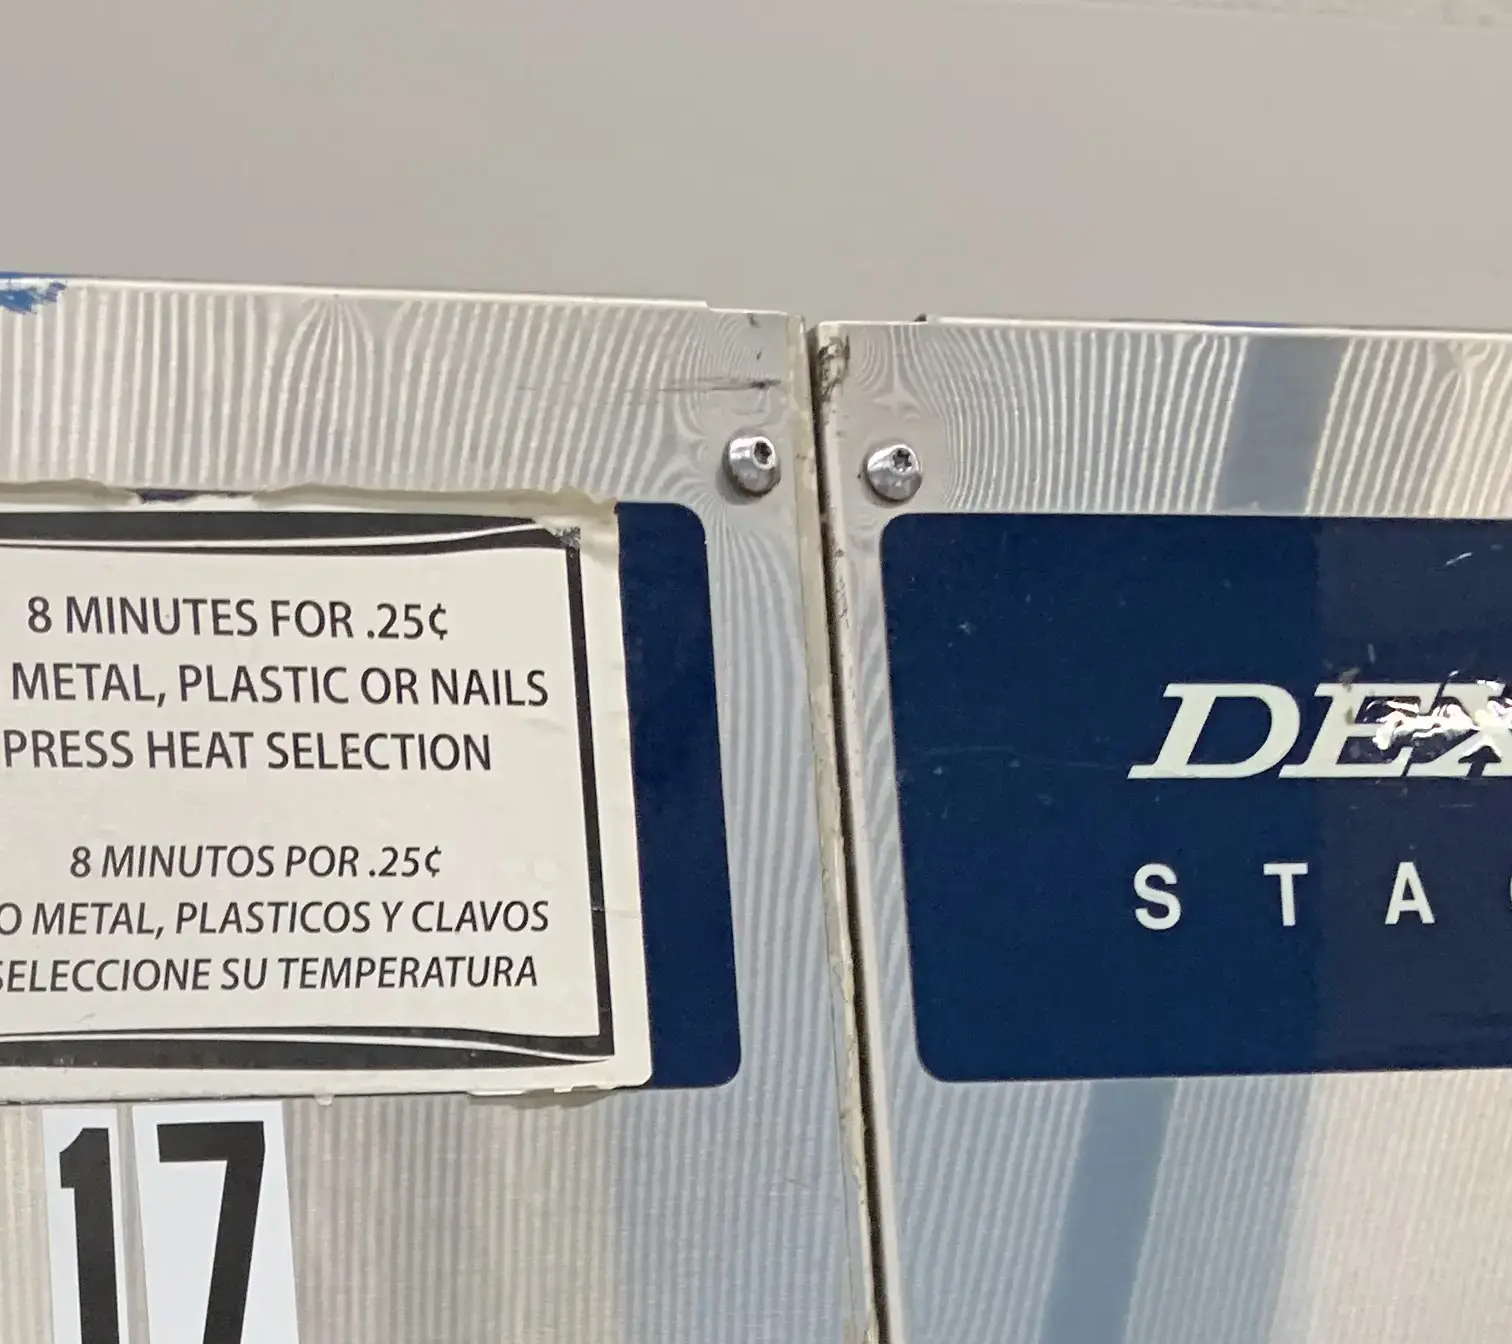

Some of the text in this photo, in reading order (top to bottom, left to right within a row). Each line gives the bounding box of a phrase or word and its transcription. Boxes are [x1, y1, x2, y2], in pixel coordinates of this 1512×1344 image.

[28, 596, 448, 641] 8 MINUTES FOR .25¢
[12, 662, 166, 708] METAL,
[179, 664, 349, 704] PLASTIC
[360, 667, 419, 705] OR
[431, 668, 548, 707] NAILS
[3, 729, 491, 771] PRESS HEAT SELECTION
[70, 845, 442, 878] 8 MINUTOS POR .25¢
[1133, 861, 1512, 931] STA
[32, 902, 164, 940] METAL,
[175, 901, 371, 934] PLASTICOS
[381, 901, 404, 933] Y
[412, 900, 549, 933] CLAVOS
[220, 957, 268, 990] SU
[277, 955, 538, 989] TEMPERATURA
